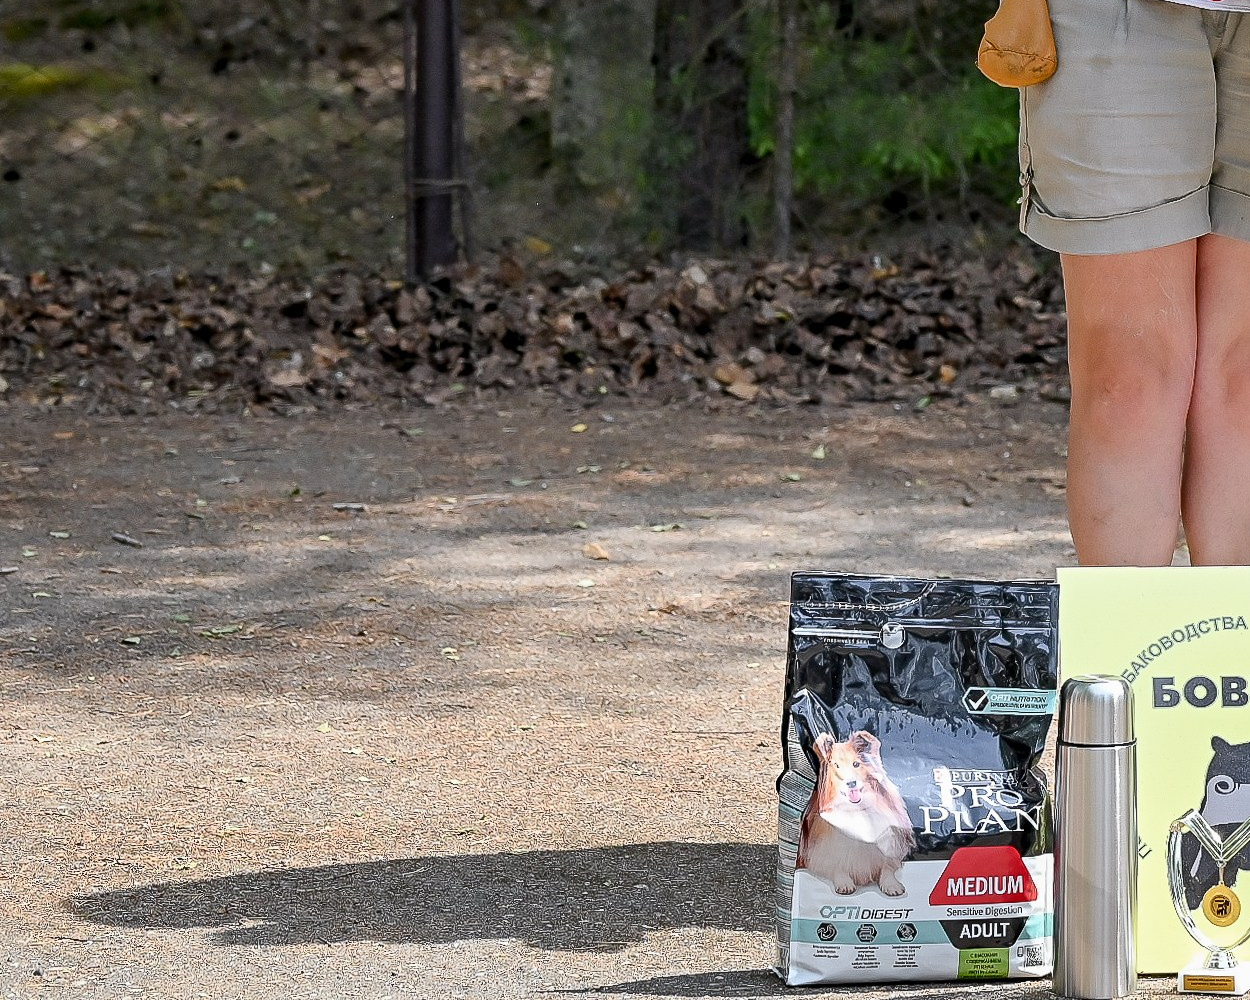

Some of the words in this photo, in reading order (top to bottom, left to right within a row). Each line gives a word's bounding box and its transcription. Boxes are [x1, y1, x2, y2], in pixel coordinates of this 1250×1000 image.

[1121, 615, 1249, 683] БАКОВОДСТВА
[951, 770, 1017, 784] PURINA
[938, 783, 1024, 809] PRO
[919, 804, 1043, 835] PLAN
[946, 875, 1024, 897] MEDIUM
[946, 907, 984, 917] Sensitive
[985, 905, 1023, 918] Digestion
[959, 922, 1010, 939] ADULT
